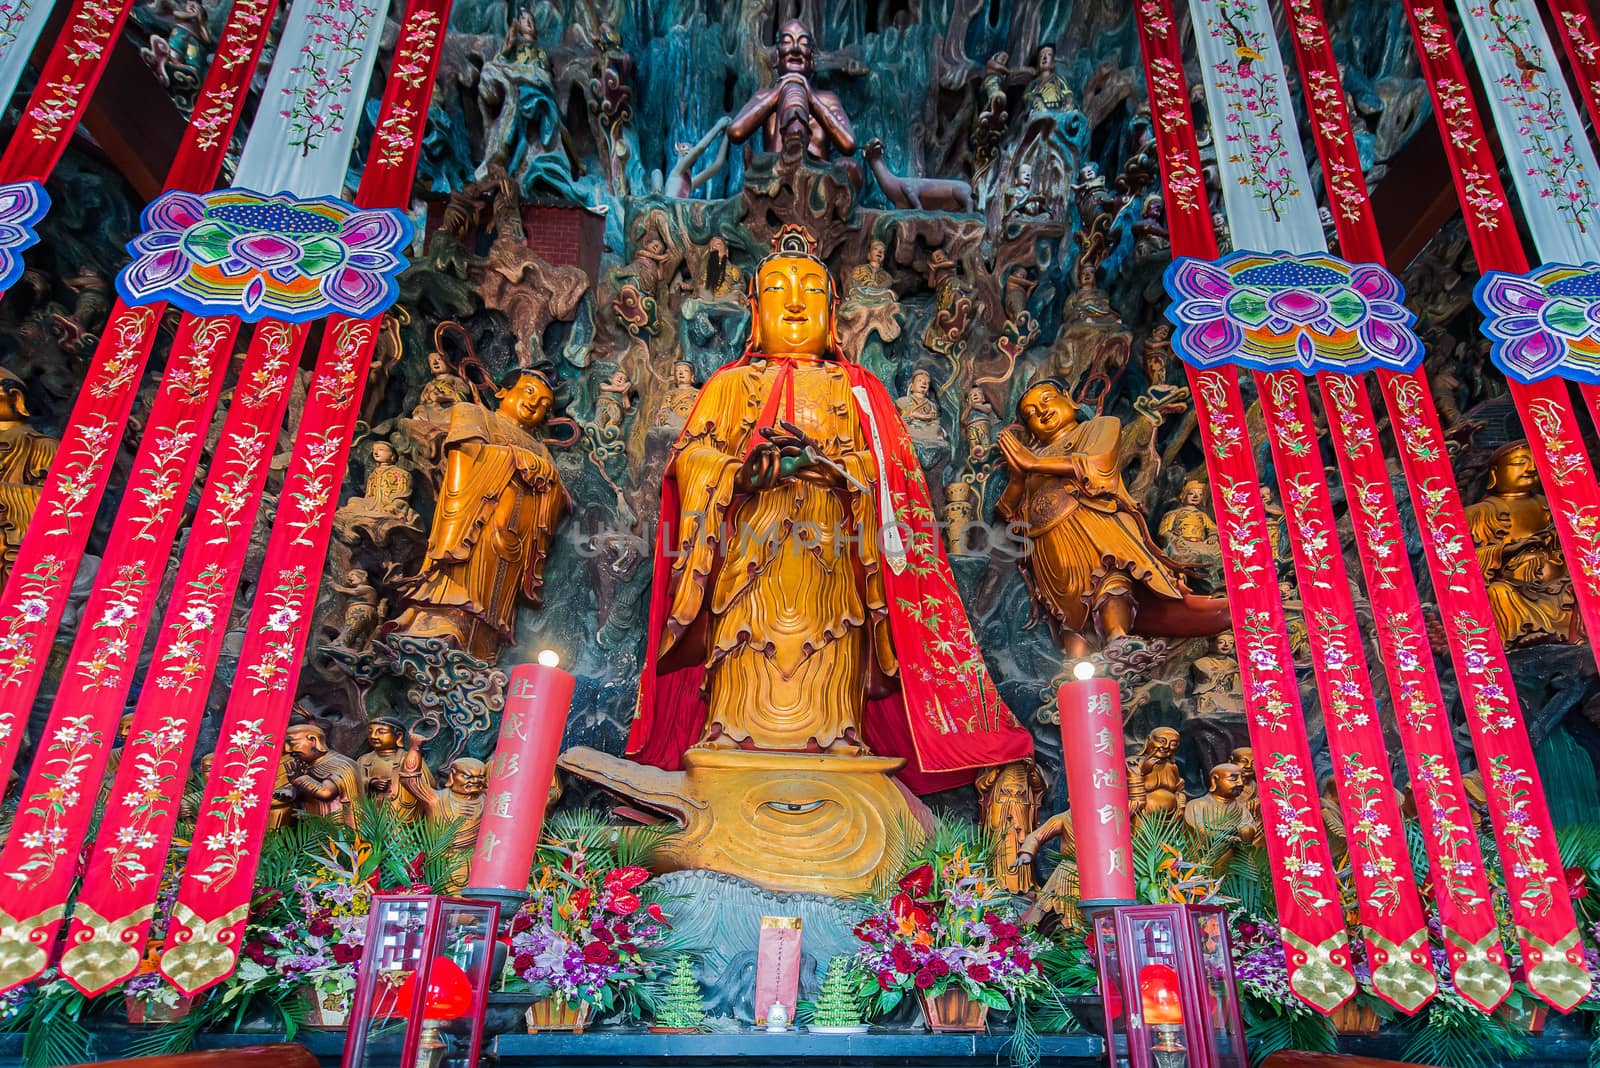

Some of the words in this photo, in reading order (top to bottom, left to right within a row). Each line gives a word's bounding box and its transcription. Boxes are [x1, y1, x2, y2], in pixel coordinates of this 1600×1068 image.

[1087, 692, 1127, 877] 現身池印月
